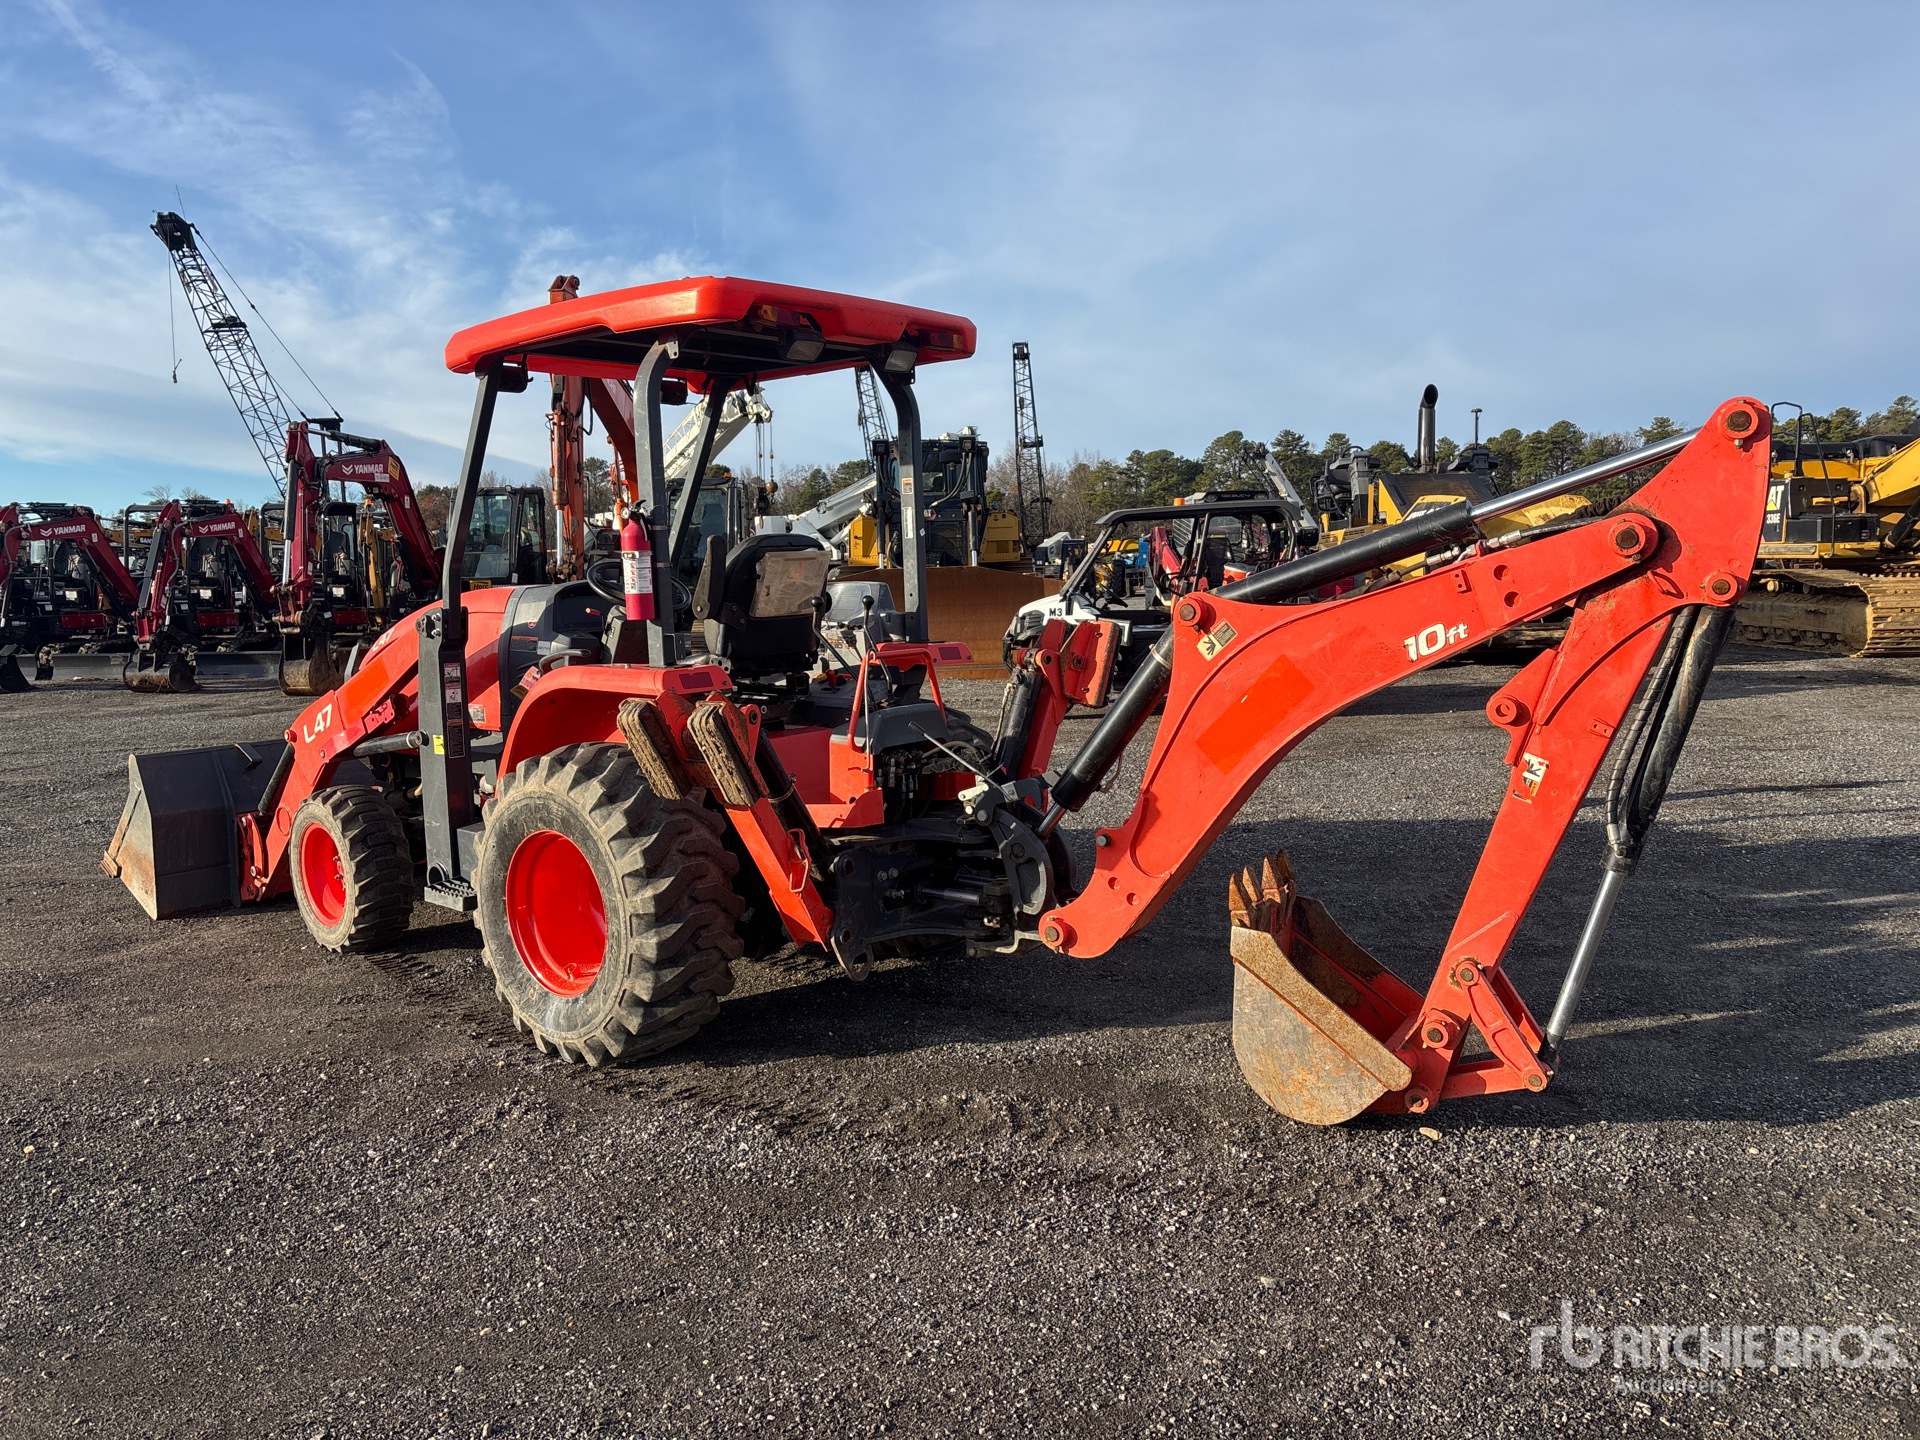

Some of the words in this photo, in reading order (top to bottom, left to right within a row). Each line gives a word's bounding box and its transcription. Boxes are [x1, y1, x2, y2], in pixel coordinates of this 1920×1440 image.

[354, 464, 384, 474] YANMAR
[1766, 513, 1781, 524] 336E
[53, 524, 86, 535] YANMAR
[209, 521, 236, 532] YANMAR
[1049, 607, 1063, 617] M3
[372, 627, 396, 652] L47
[303, 703, 333, 744] L47
